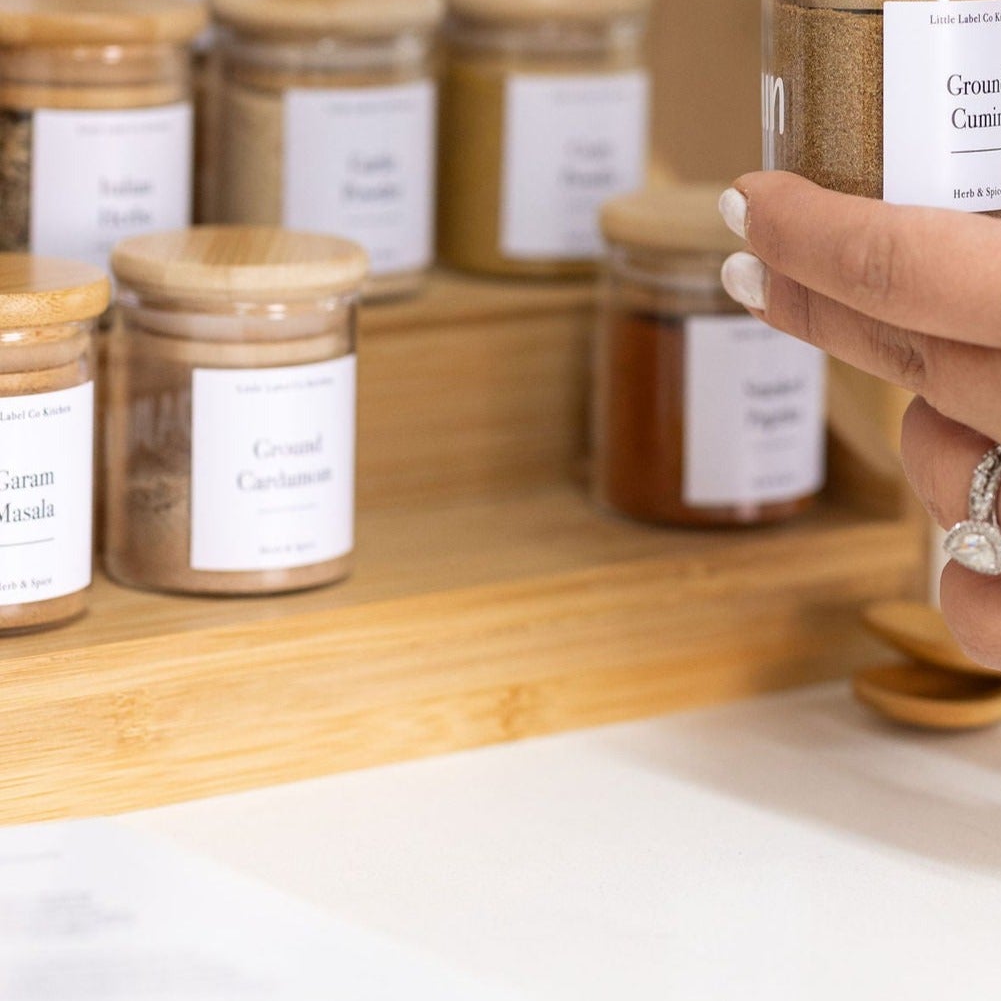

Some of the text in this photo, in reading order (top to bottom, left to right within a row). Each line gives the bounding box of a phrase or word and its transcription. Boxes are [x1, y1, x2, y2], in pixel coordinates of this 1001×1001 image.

[929, 14, 956, 25] Little
[958, 13, 981, 24] Label
[982, 12, 994, 23] Co
[953, 188, 975, 199] Herb
[976, 187, 984, 198] &
[0, 409, 26, 422] Label
[28, 408, 41, 419] Co
